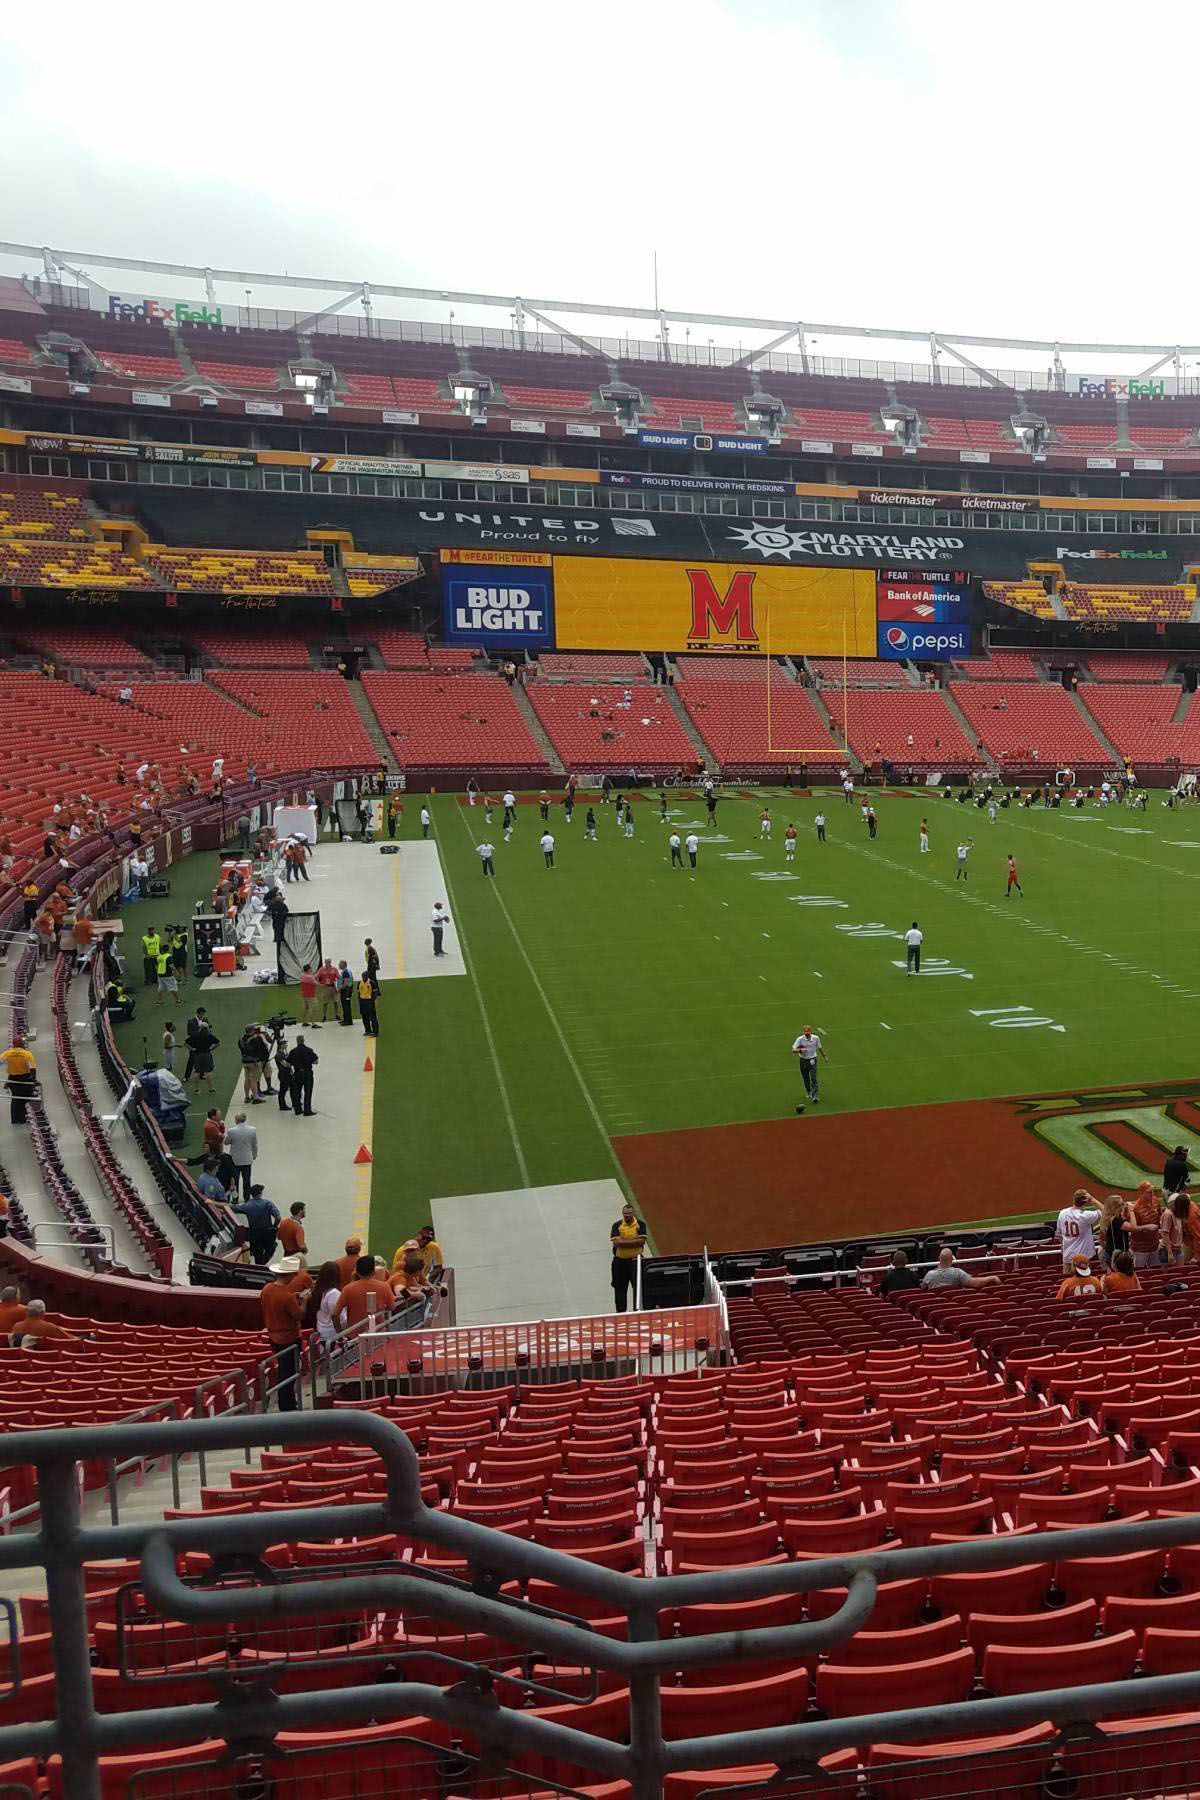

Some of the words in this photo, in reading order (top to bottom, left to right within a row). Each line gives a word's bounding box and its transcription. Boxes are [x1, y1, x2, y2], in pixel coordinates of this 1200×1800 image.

[109, 296, 221, 324] FedExField
[1079, 378, 1164, 395] FedExField
[643, 435, 661, 445] BUD
[662, 436, 688, 446] LIGHT
[718, 440, 737, 450] BUD
[737, 442, 762, 451] LIGHT
[155, 452, 184, 461] SALUTE
[503, 470, 520, 480] sas
[611, 475, 630, 483] FedEx
[642, 478, 669, 487] PROUD
[670, 479, 681, 487] TO
[682, 480, 714, 489] DELIVER
[715, 482, 728, 490] FOR
[728, 483, 745, 491] THE
[870, 491, 937, 506] ticketmaster
[962, 497, 1027, 511] ticketmaster
[419, 511, 600, 530] UNITED
[481, 530, 540, 541] Proud
[548, 533, 568, 542] to
[576, 534, 600, 544] fly
[810, 532, 965, 549] MARYLAND
[814, 544, 940, 561] LOTTERY
[1056, 547, 1168, 559] FedExField
[467, 587, 530, 609] BUD
[887, 590, 911, 600] Bank
[912, 591, 922, 600] of
[922, 591, 960, 602] America
[685, 569, 759, 641] M
[456, 608, 542, 630] LIGHT
[913, 633, 963, 651] pepsi
[372, 780, 406, 789] SUTE
[968, 1005, 1054, 1028] 10
[1064, 1220, 1080, 1237] 10
